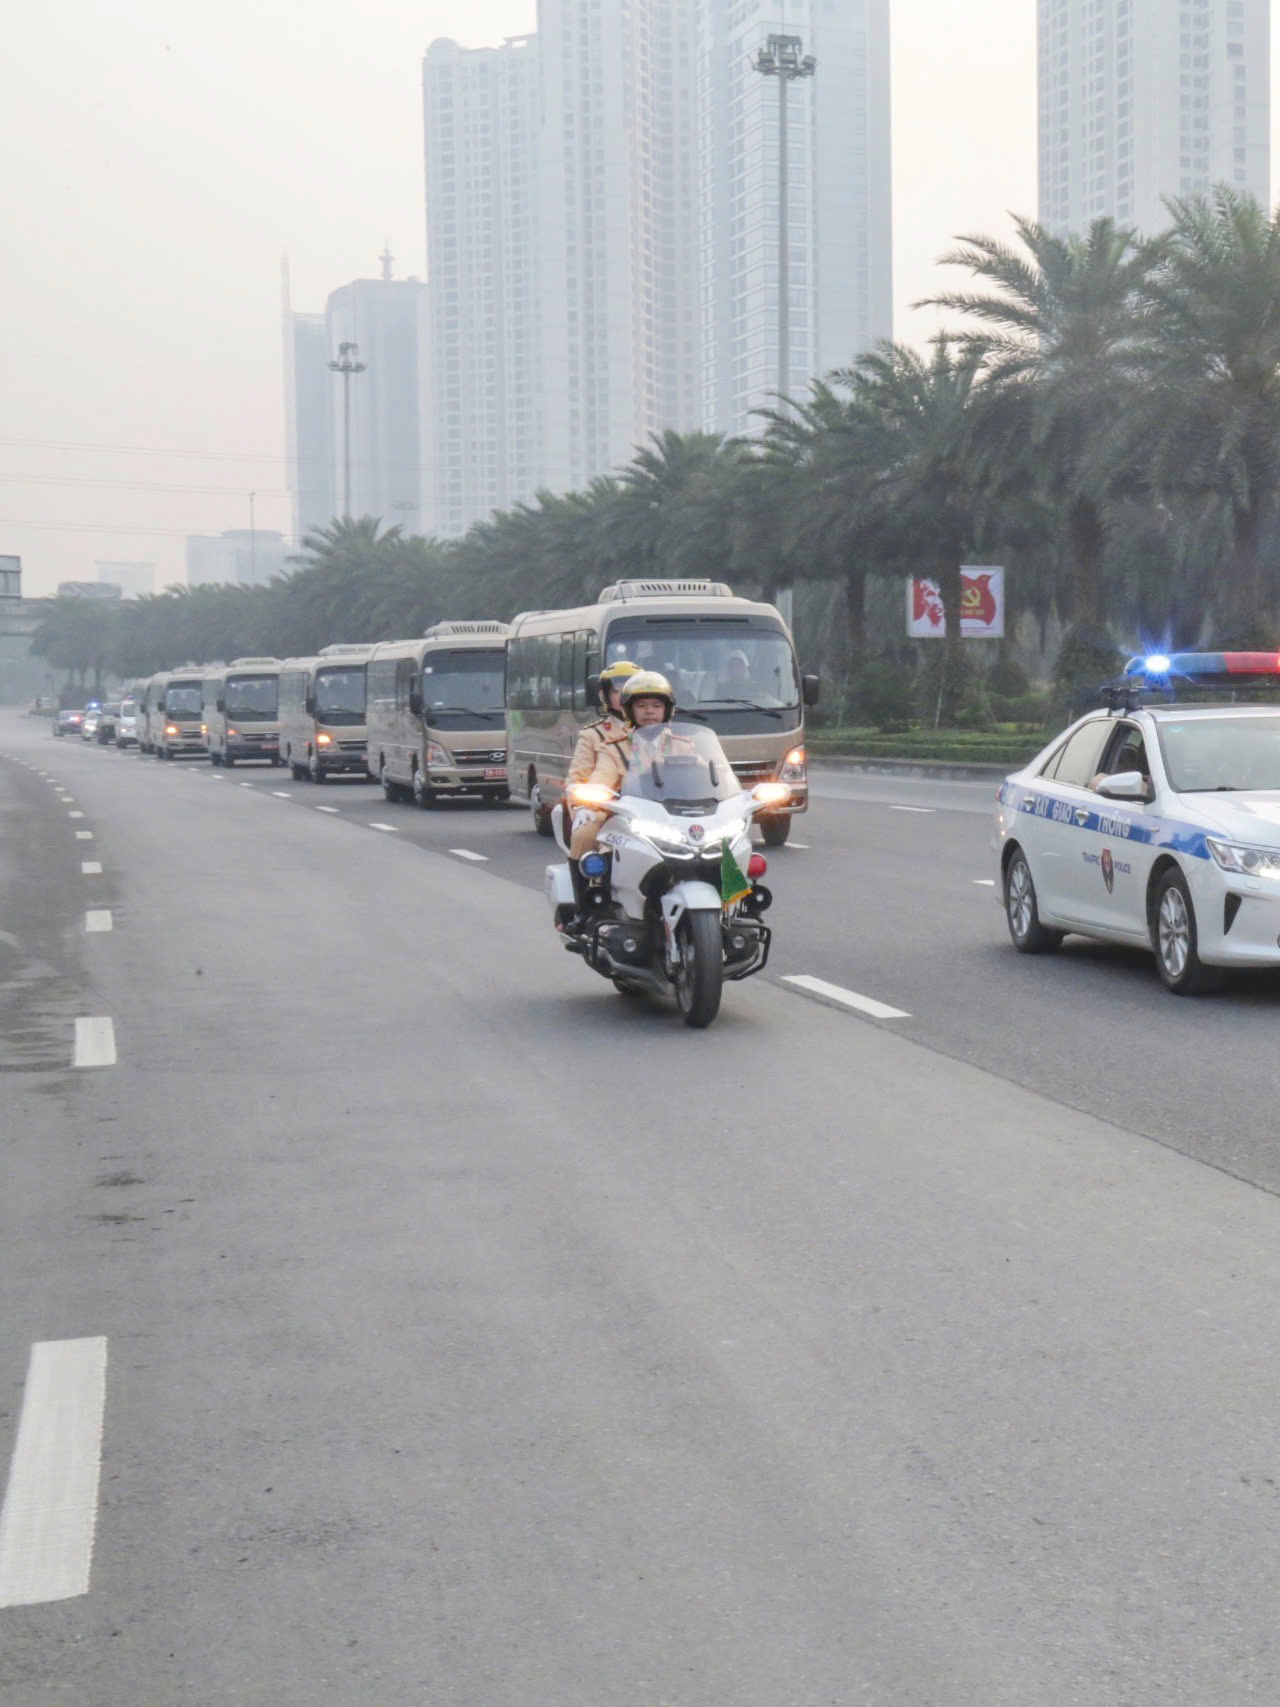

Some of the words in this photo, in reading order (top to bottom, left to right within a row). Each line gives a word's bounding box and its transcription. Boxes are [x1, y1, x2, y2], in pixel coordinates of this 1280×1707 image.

[1052, 801, 1072, 824] GIAO
[607, 833, 631, 847] CSGT
[1114, 861, 1131, 874] POLICE
